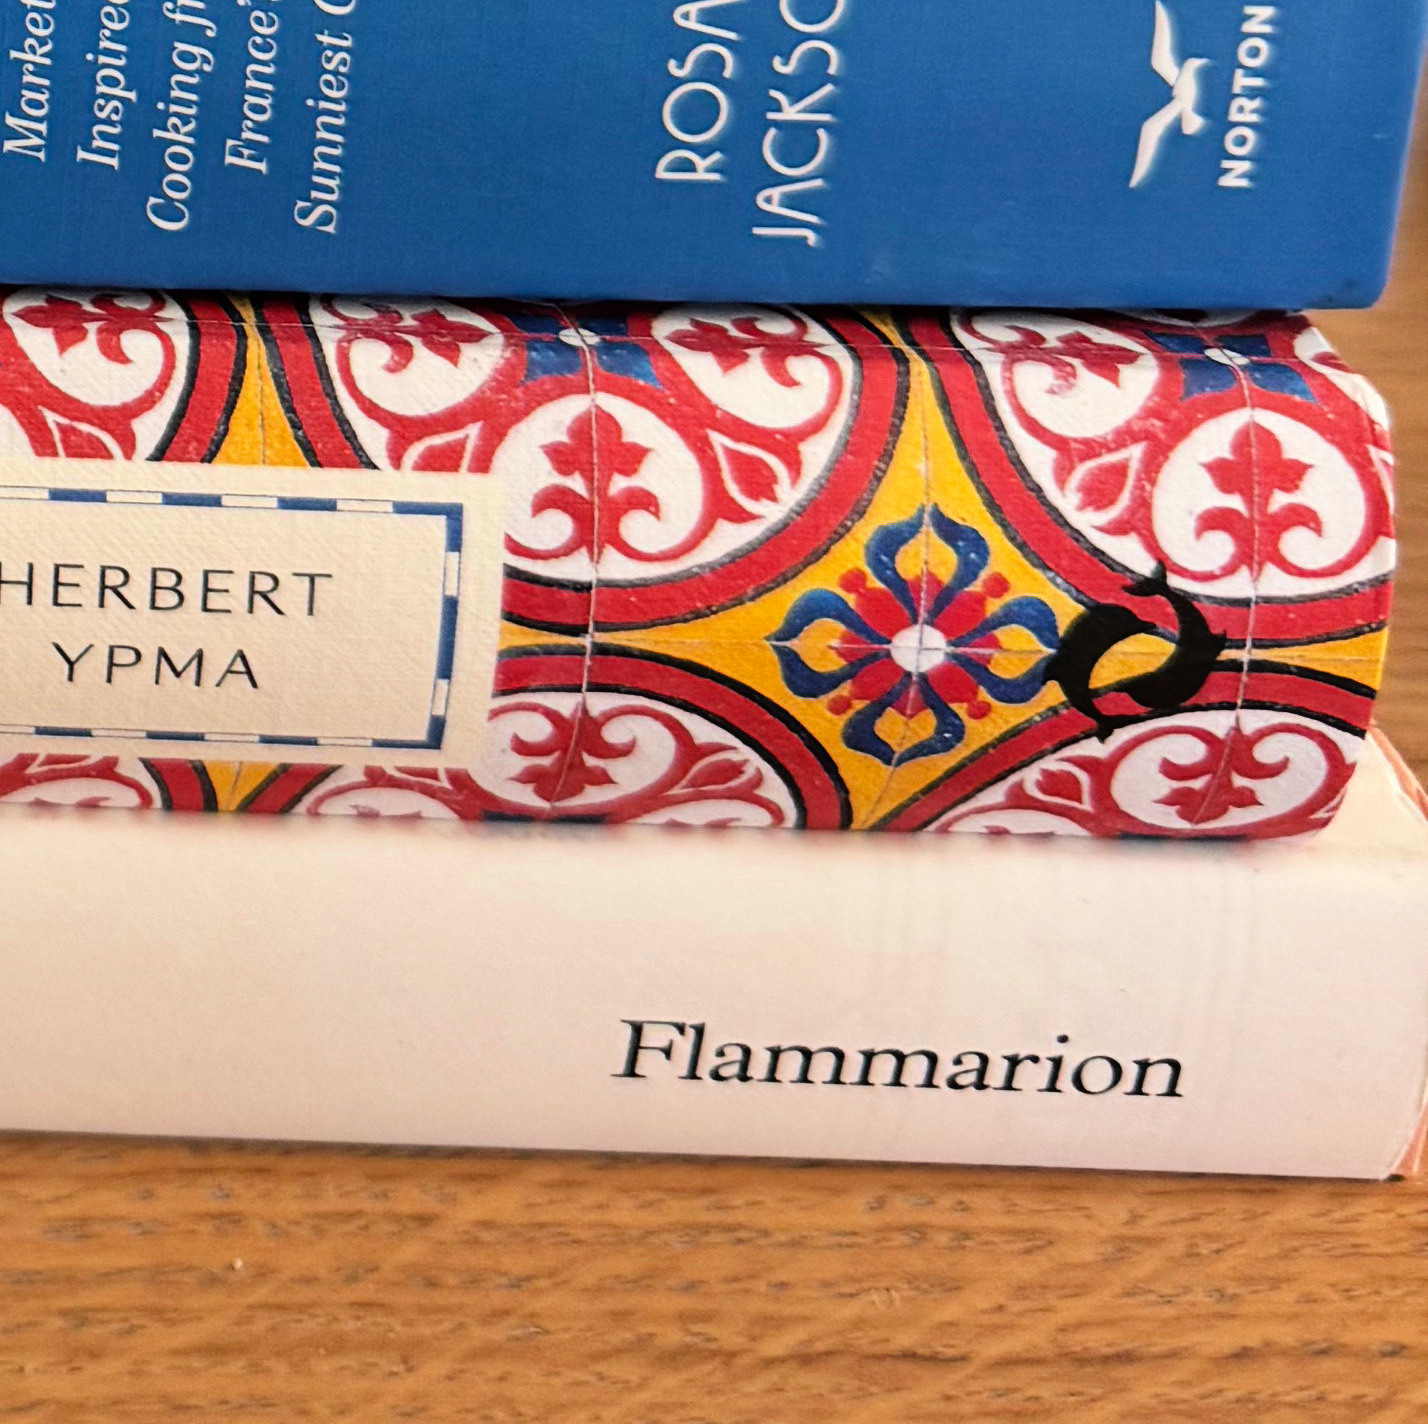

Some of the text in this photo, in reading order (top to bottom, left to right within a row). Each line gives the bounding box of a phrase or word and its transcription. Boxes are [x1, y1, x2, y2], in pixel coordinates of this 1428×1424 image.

[145, 40, 215, 232] Cooking
[293, 29, 355, 235] Sunniest
[1218, 5, 1279, 189] NORTON
[51, 641, 261, 690] YPMA
[610, 1018, 1185, 1098] Flammarion
